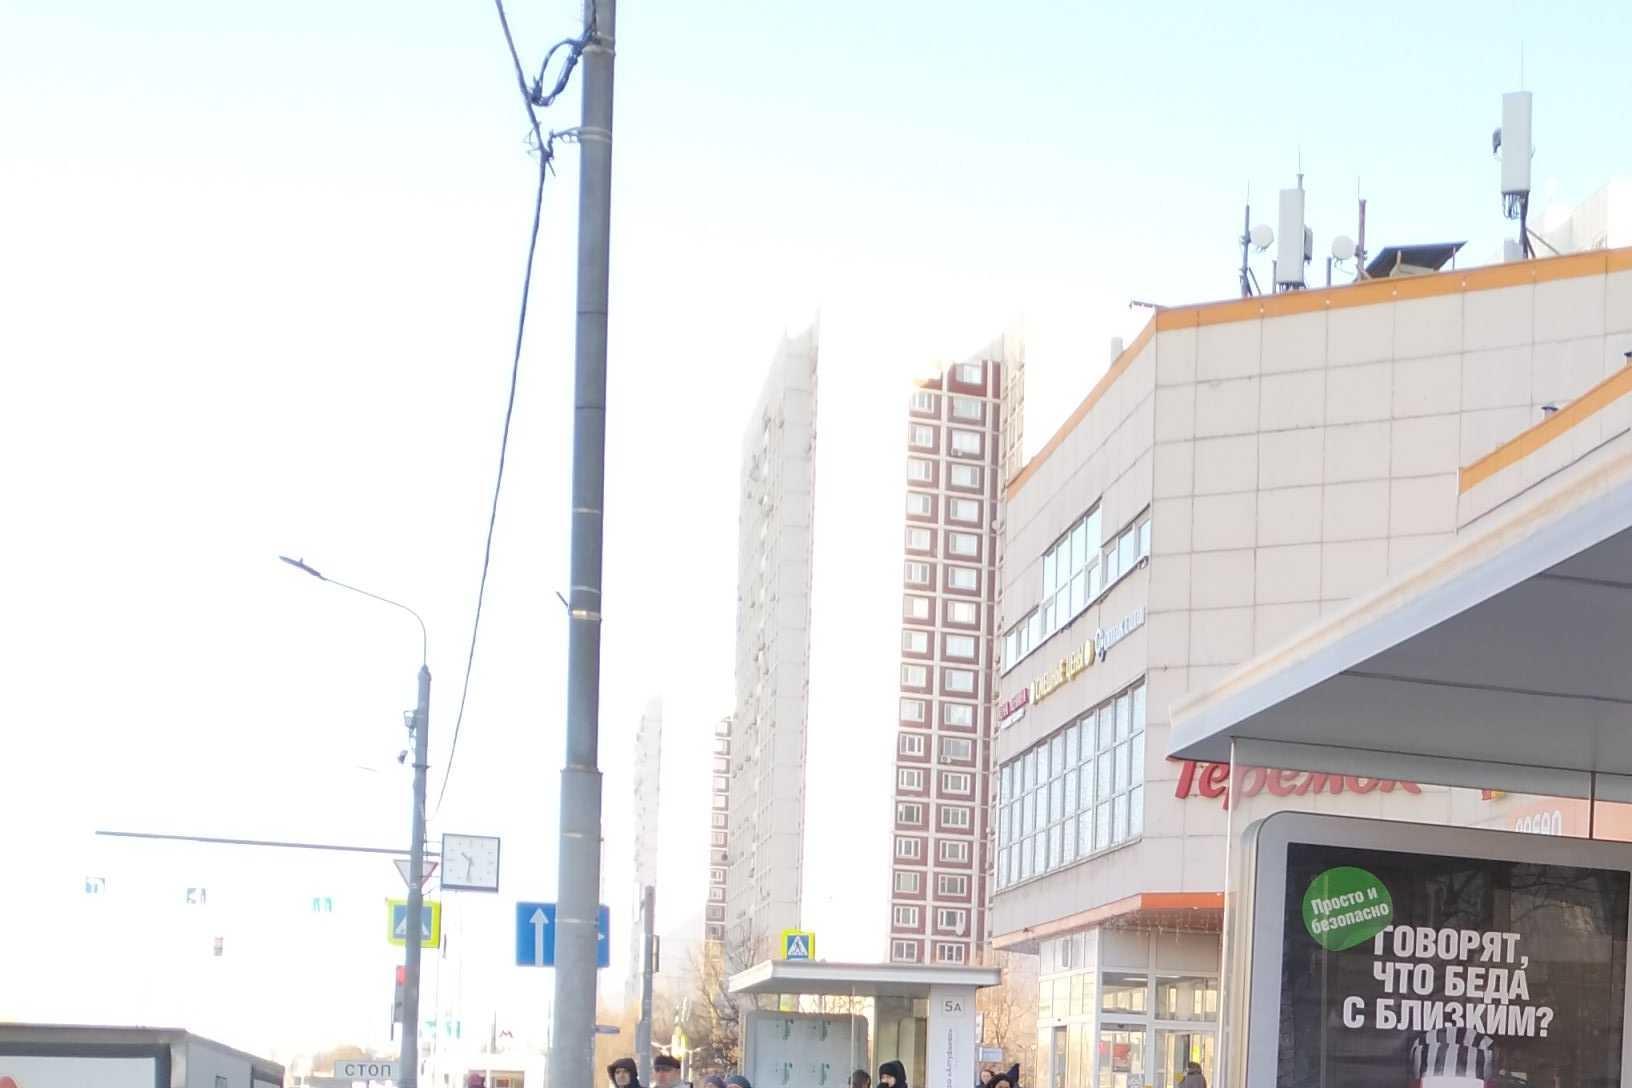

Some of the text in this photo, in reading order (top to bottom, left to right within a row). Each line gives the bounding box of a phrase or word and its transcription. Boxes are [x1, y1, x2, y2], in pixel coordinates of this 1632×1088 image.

[1310, 887, 1378, 917] Просто и
[1311, 903, 1390, 935] безопасно
[1373, 925, 1528, 969] ГОВОРЯТ,
[1373, 961, 1530, 1004] ЧТО БЕДА
[1343, 996, 1555, 1038] С БЛИЗКИМ?
[344, 1063, 391, 1078] СТОП
